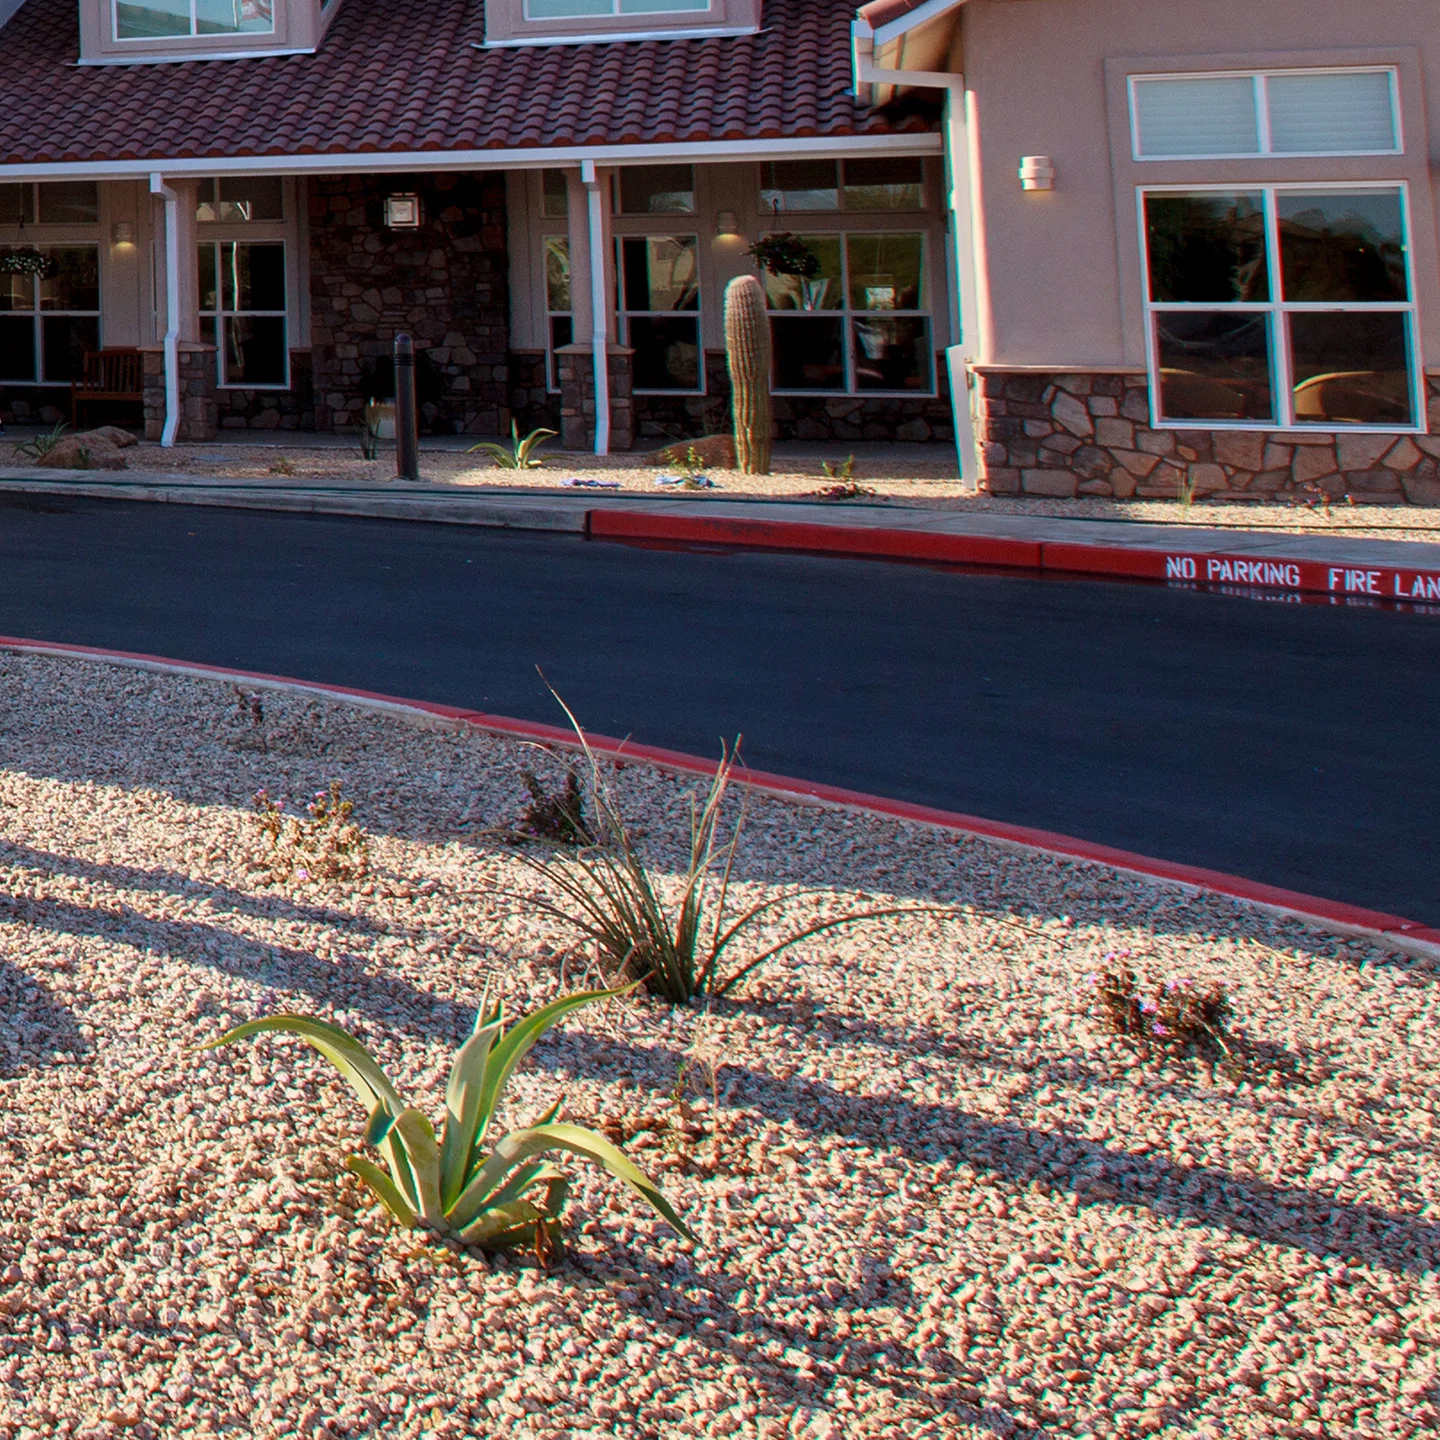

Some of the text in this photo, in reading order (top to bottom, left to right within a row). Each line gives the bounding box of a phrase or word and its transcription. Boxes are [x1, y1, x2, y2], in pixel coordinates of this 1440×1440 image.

[1166, 556, 1196, 579] NO
[1207, 558, 1300, 587] PARKING
[1328, 567, 1382, 595] FIRE
